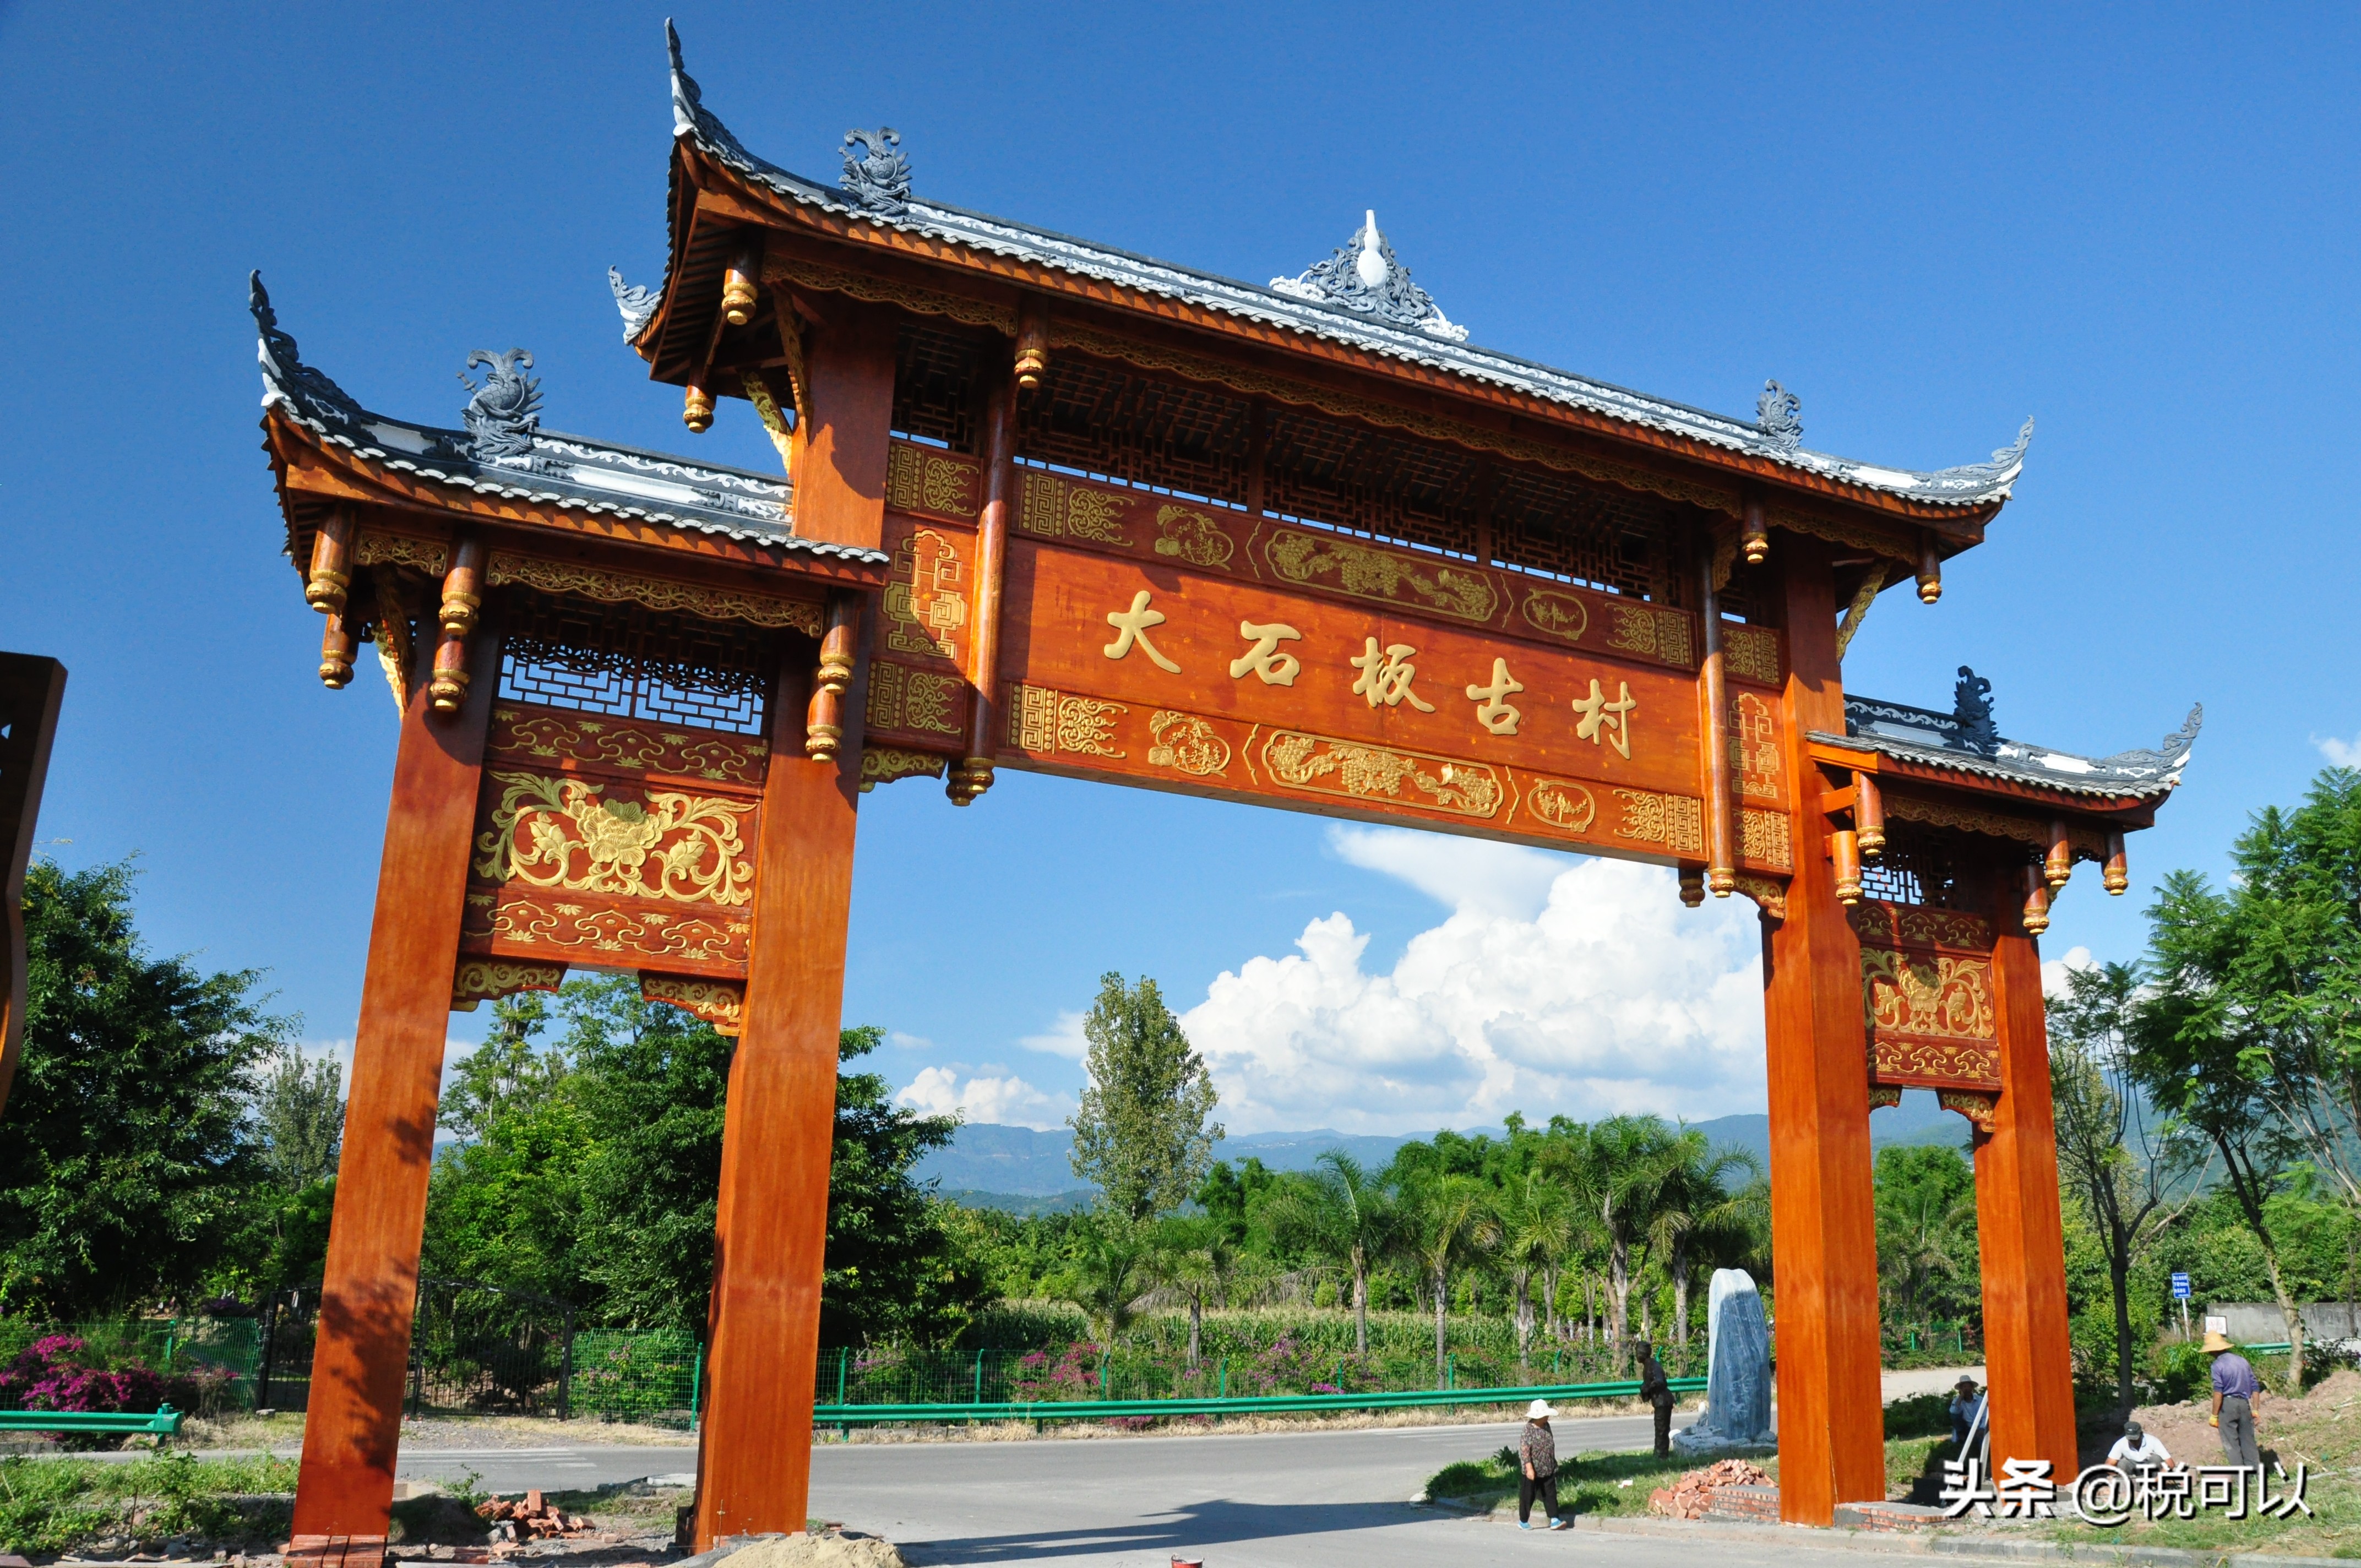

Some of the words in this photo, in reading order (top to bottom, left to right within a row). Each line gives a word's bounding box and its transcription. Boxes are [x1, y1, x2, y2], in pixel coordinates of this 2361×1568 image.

[1104, 590, 1636, 759] 大石板古村
